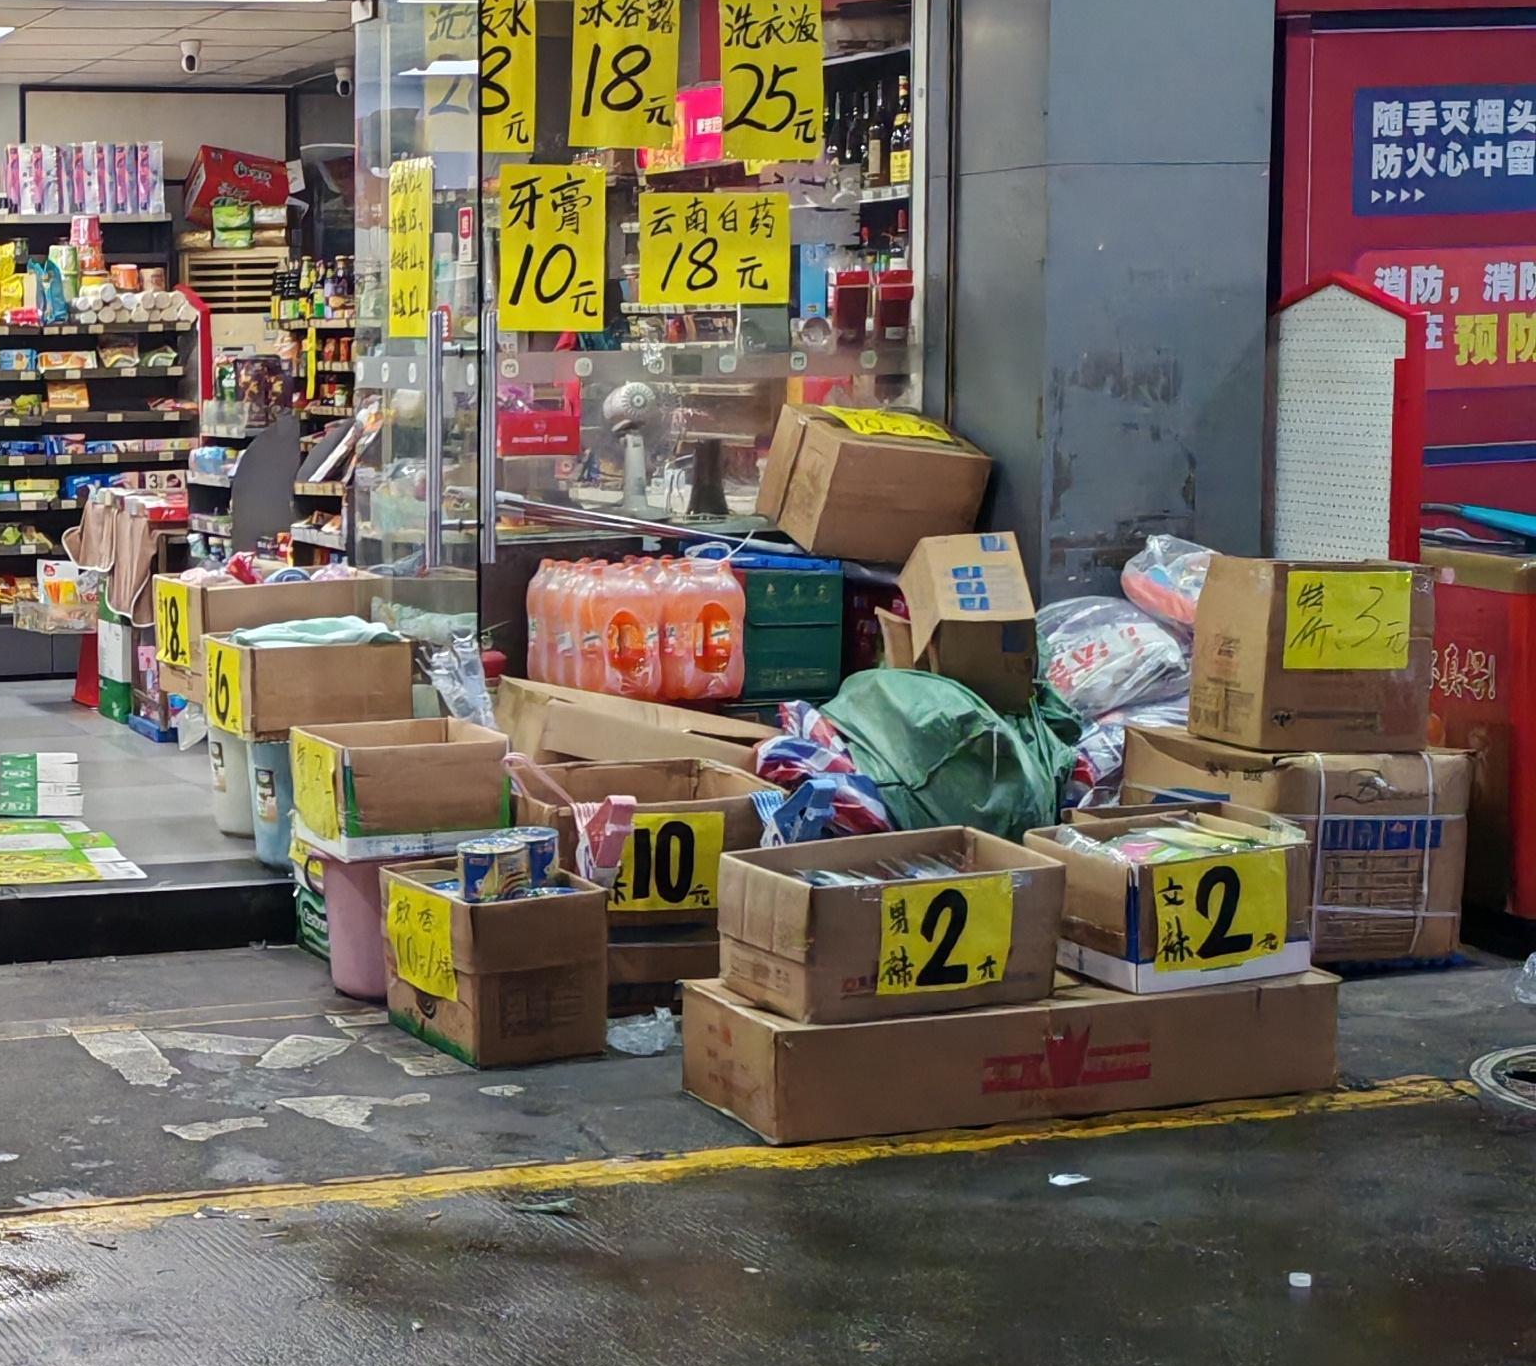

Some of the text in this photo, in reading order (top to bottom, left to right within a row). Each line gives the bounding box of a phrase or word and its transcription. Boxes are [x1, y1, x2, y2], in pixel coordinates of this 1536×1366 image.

[1373, 99, 1536, 138] 随手灭烟头
[1372, 141, 1536, 180] 防火心中留
[508, 173, 591, 235] 牙膏
[648, 197, 775, 238] 云南白药
[509, 243, 598, 316] 10元
